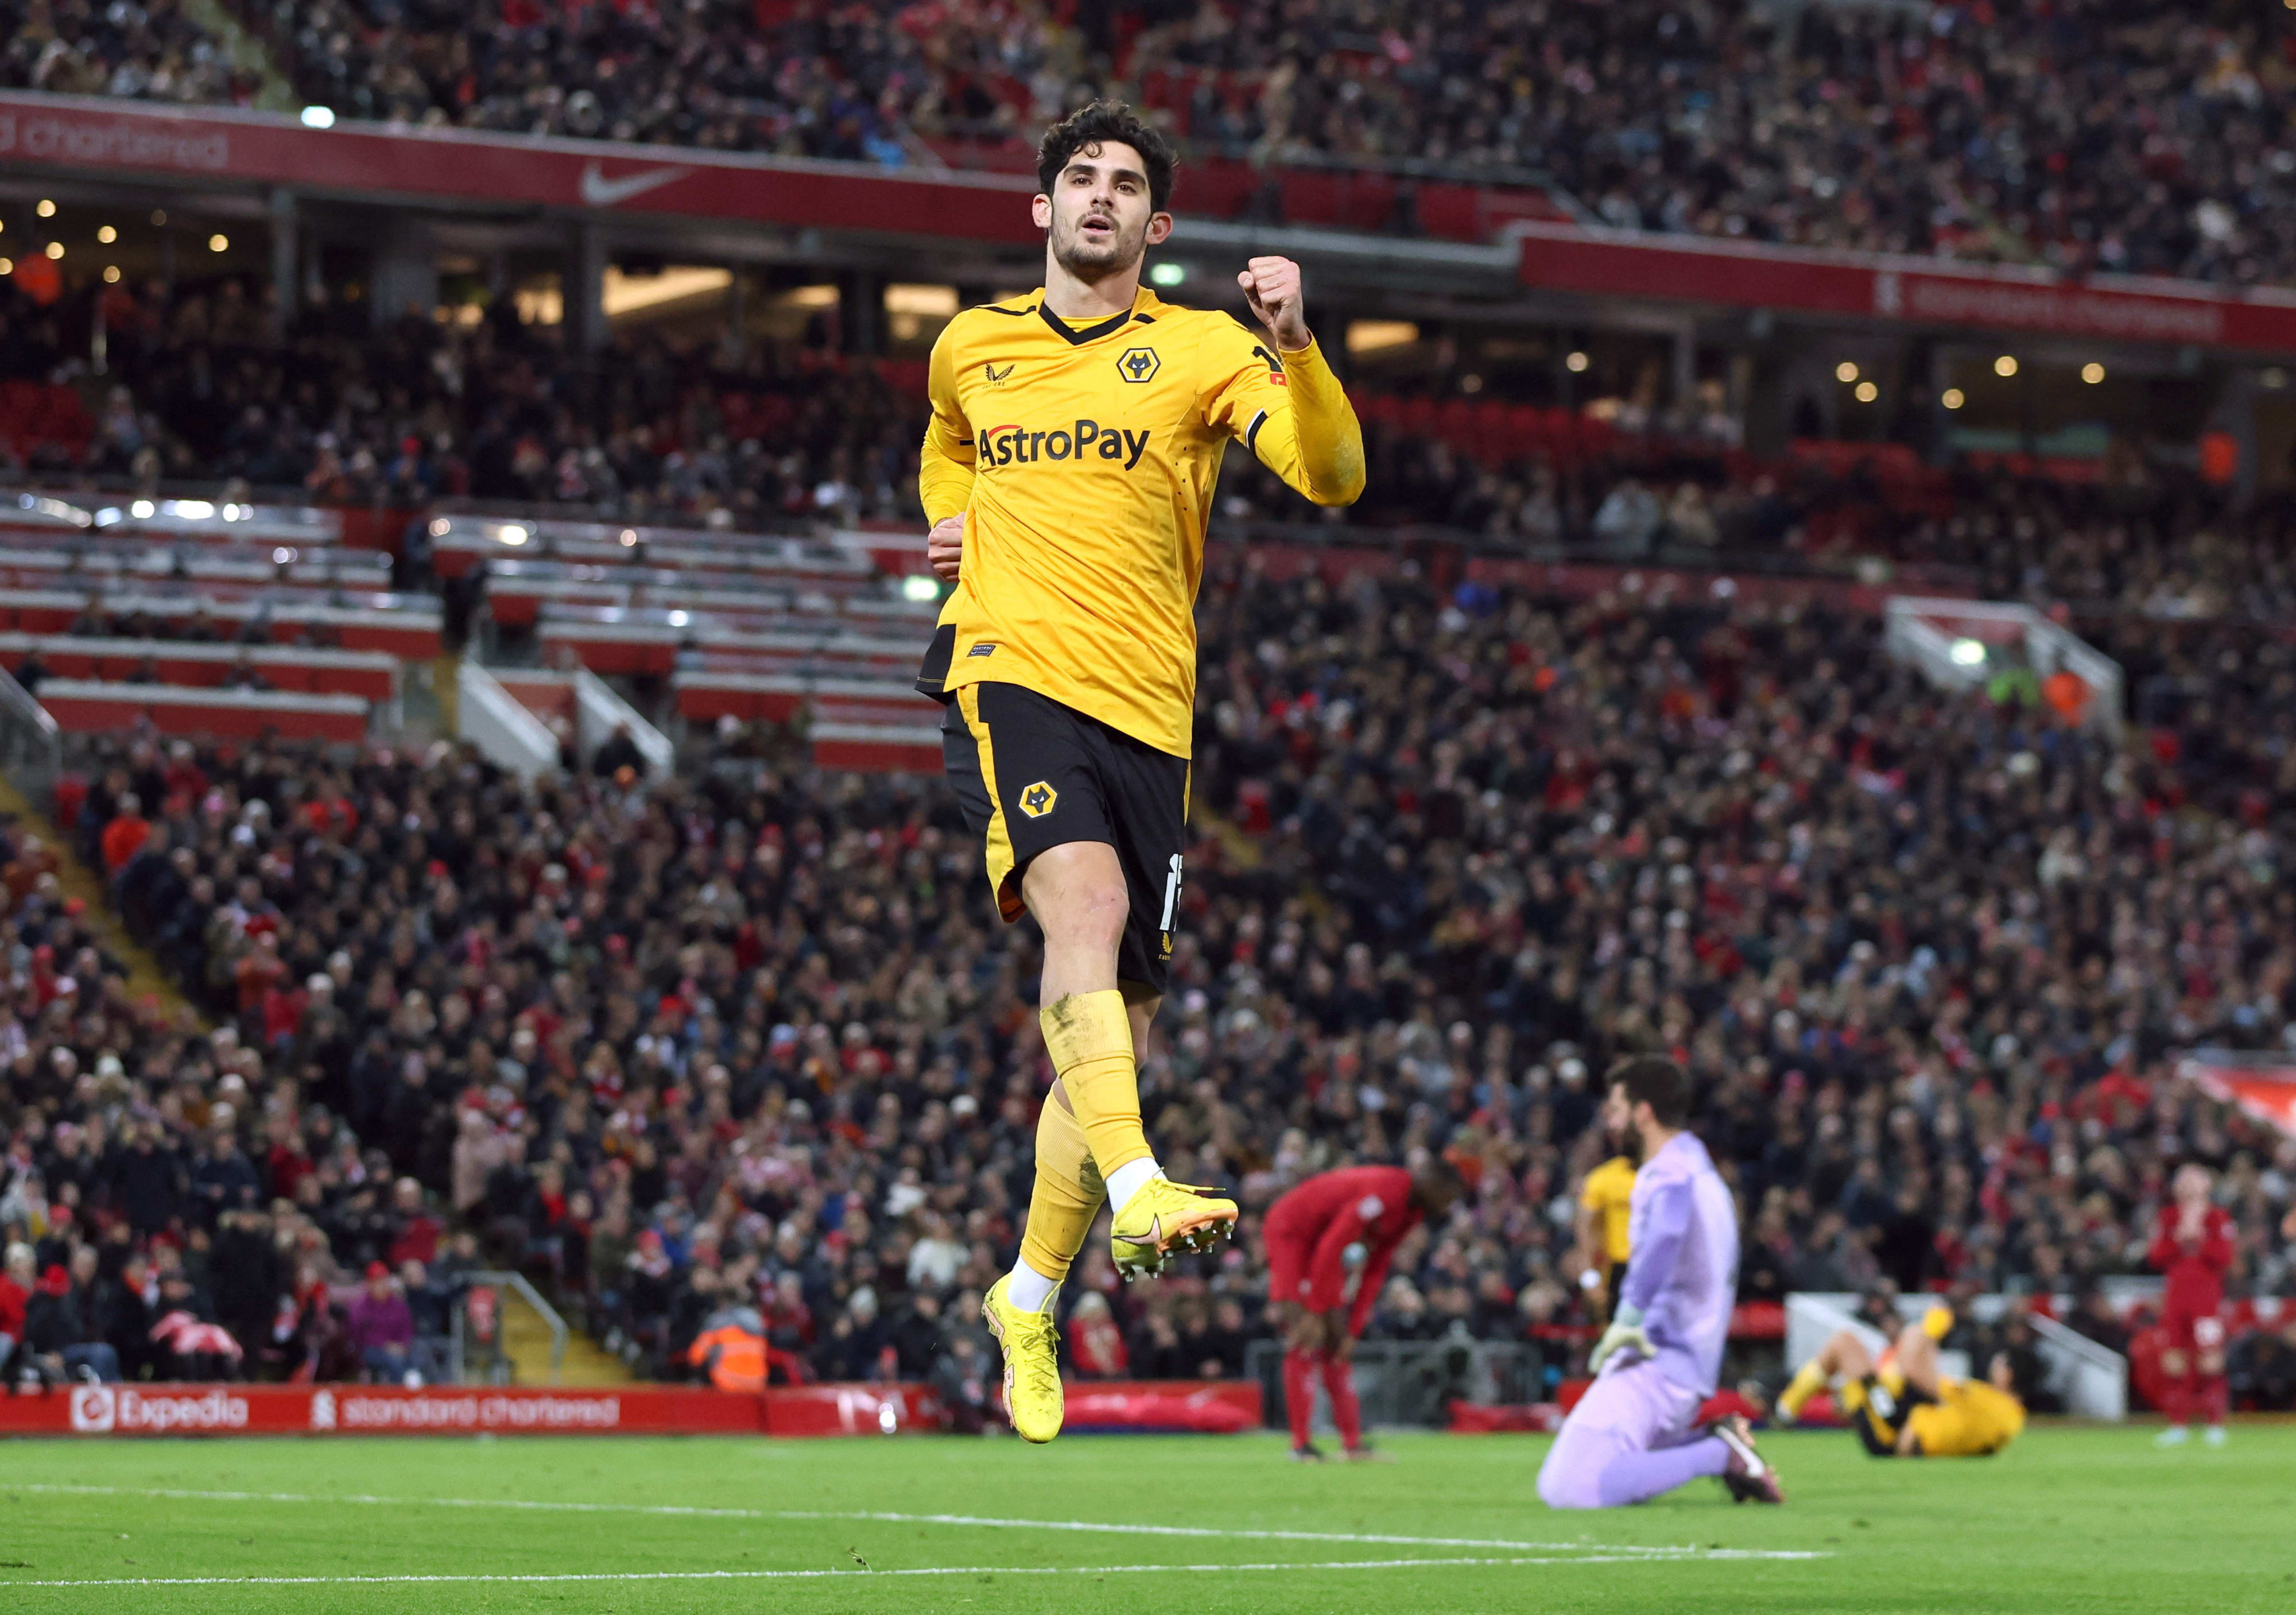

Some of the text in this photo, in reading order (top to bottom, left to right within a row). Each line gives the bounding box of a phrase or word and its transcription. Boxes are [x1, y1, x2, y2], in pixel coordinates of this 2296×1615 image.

[24, 117, 228, 168] chartered
[979, 419, 1151, 471] AstroPay
[119, 1390, 249, 1430] Expedia
